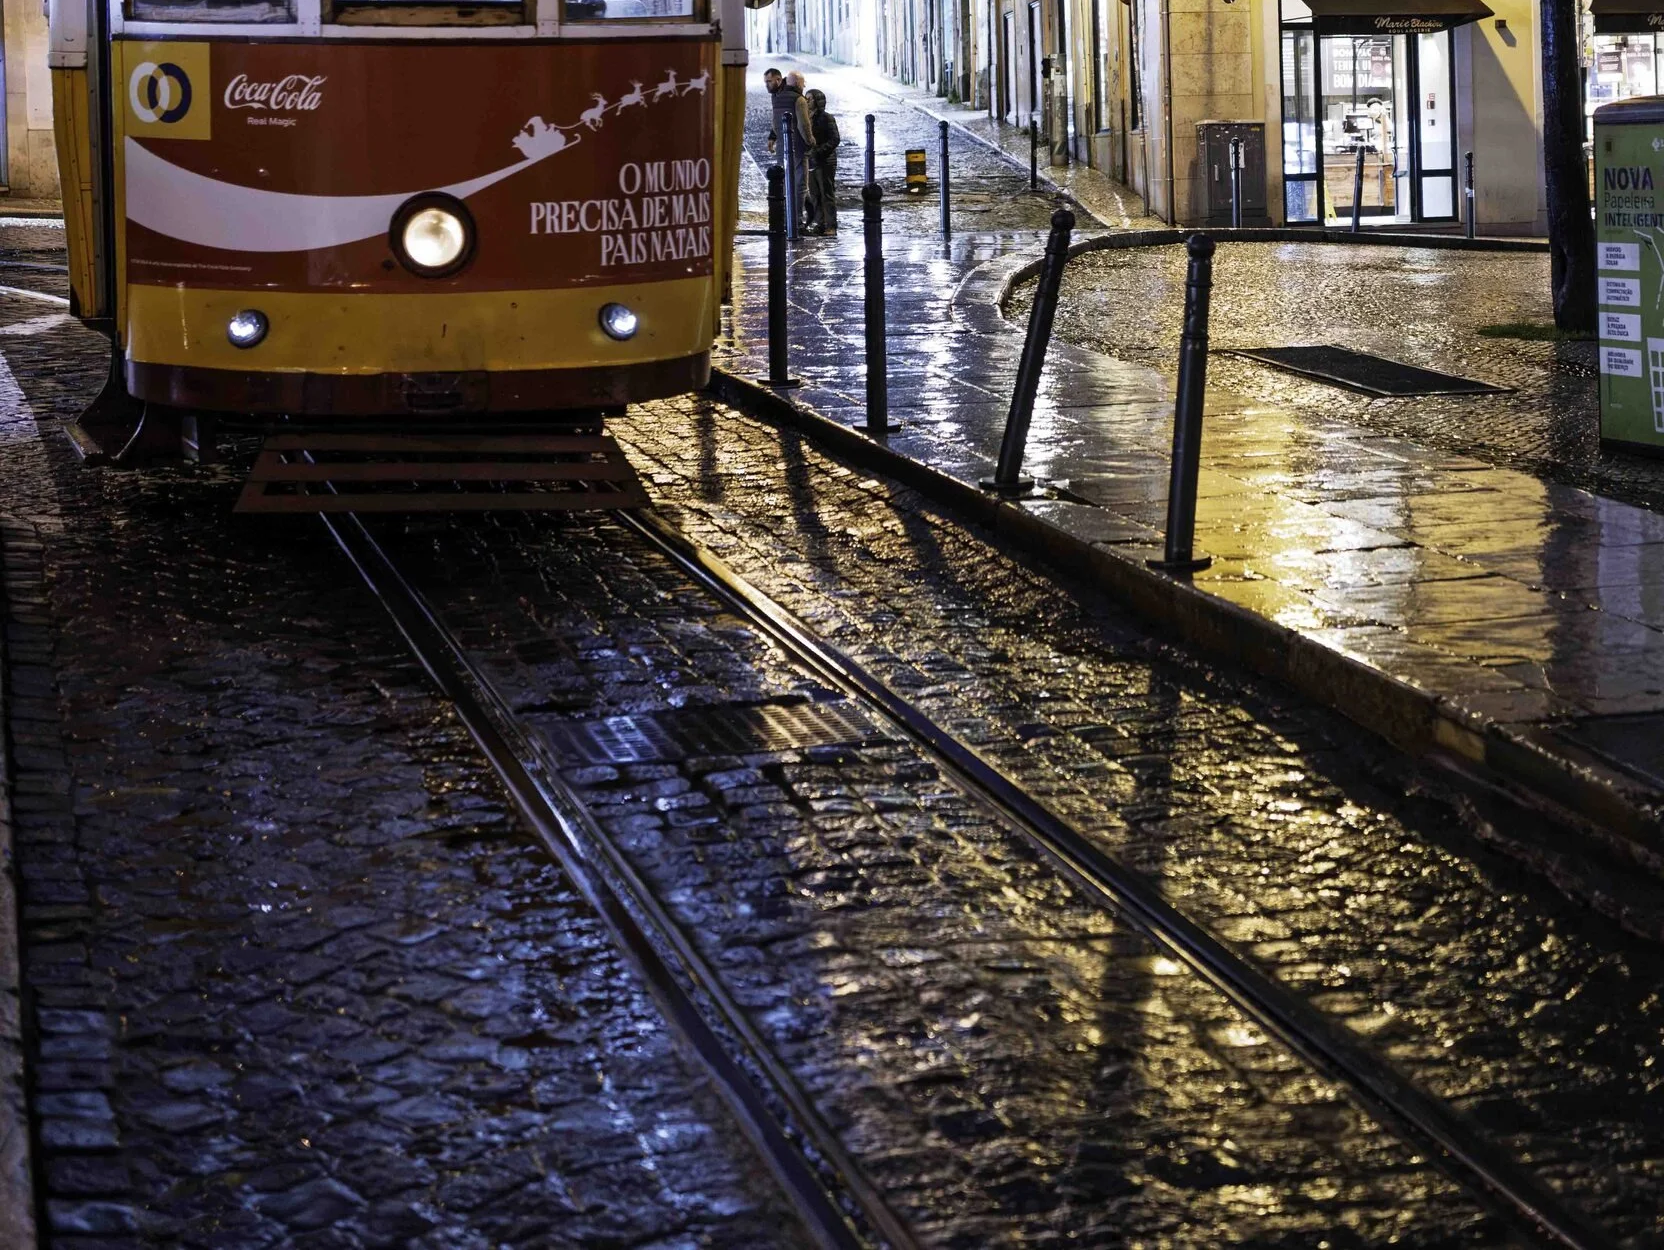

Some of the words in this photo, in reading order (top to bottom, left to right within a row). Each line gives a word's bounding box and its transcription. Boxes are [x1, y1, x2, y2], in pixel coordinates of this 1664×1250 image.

[1374, 16, 1410, 29] Marie
[223, 74, 328, 110] Coca-Cola
[247, 117, 267, 126] Real
[269, 117, 297, 128] Magic
[618, 162, 642, 195] O
[645, 158, 710, 194] MUNDO
[1604, 166, 1654, 191] NOVA
[530, 198, 638, 235] PRECISA
[642, 195, 668, 228] DE
[671, 192, 710, 226] MAIS
[1604, 212, 1664, 228] INTELIGENT
[600, 232, 647, 267] PAIS
[650, 226, 710, 263] NATAIS
